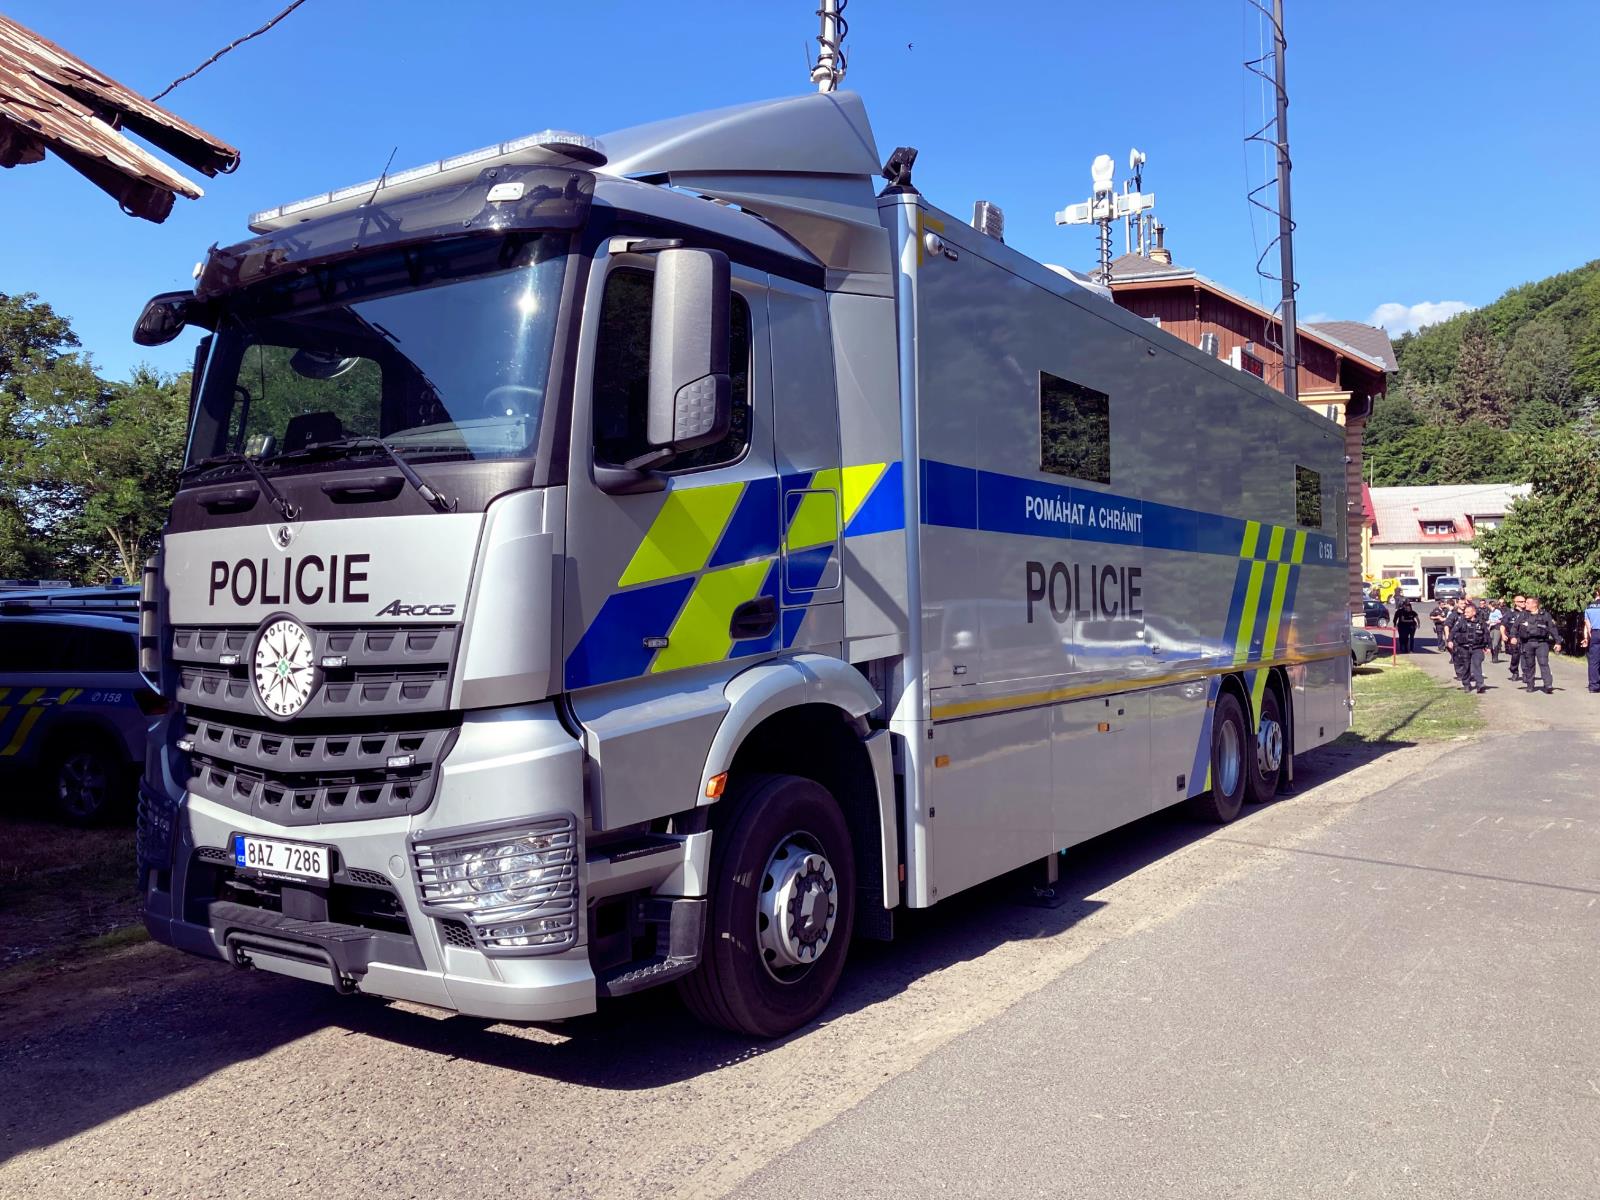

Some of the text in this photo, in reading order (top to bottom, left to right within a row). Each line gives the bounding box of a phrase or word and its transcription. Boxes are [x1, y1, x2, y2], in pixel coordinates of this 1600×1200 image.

[1025, 495, 1143, 533] POMÁHAT A CHRÁNIT
[209, 553, 370, 606] POLICIE
[1026, 561, 1143, 625] POLICIE
[264, 622, 305, 643] POLICIE
[102, 692, 122, 703] 158
[273, 650, 313, 714] REPUBLIKY
[248, 842, 321, 873] 8AZ 7286
